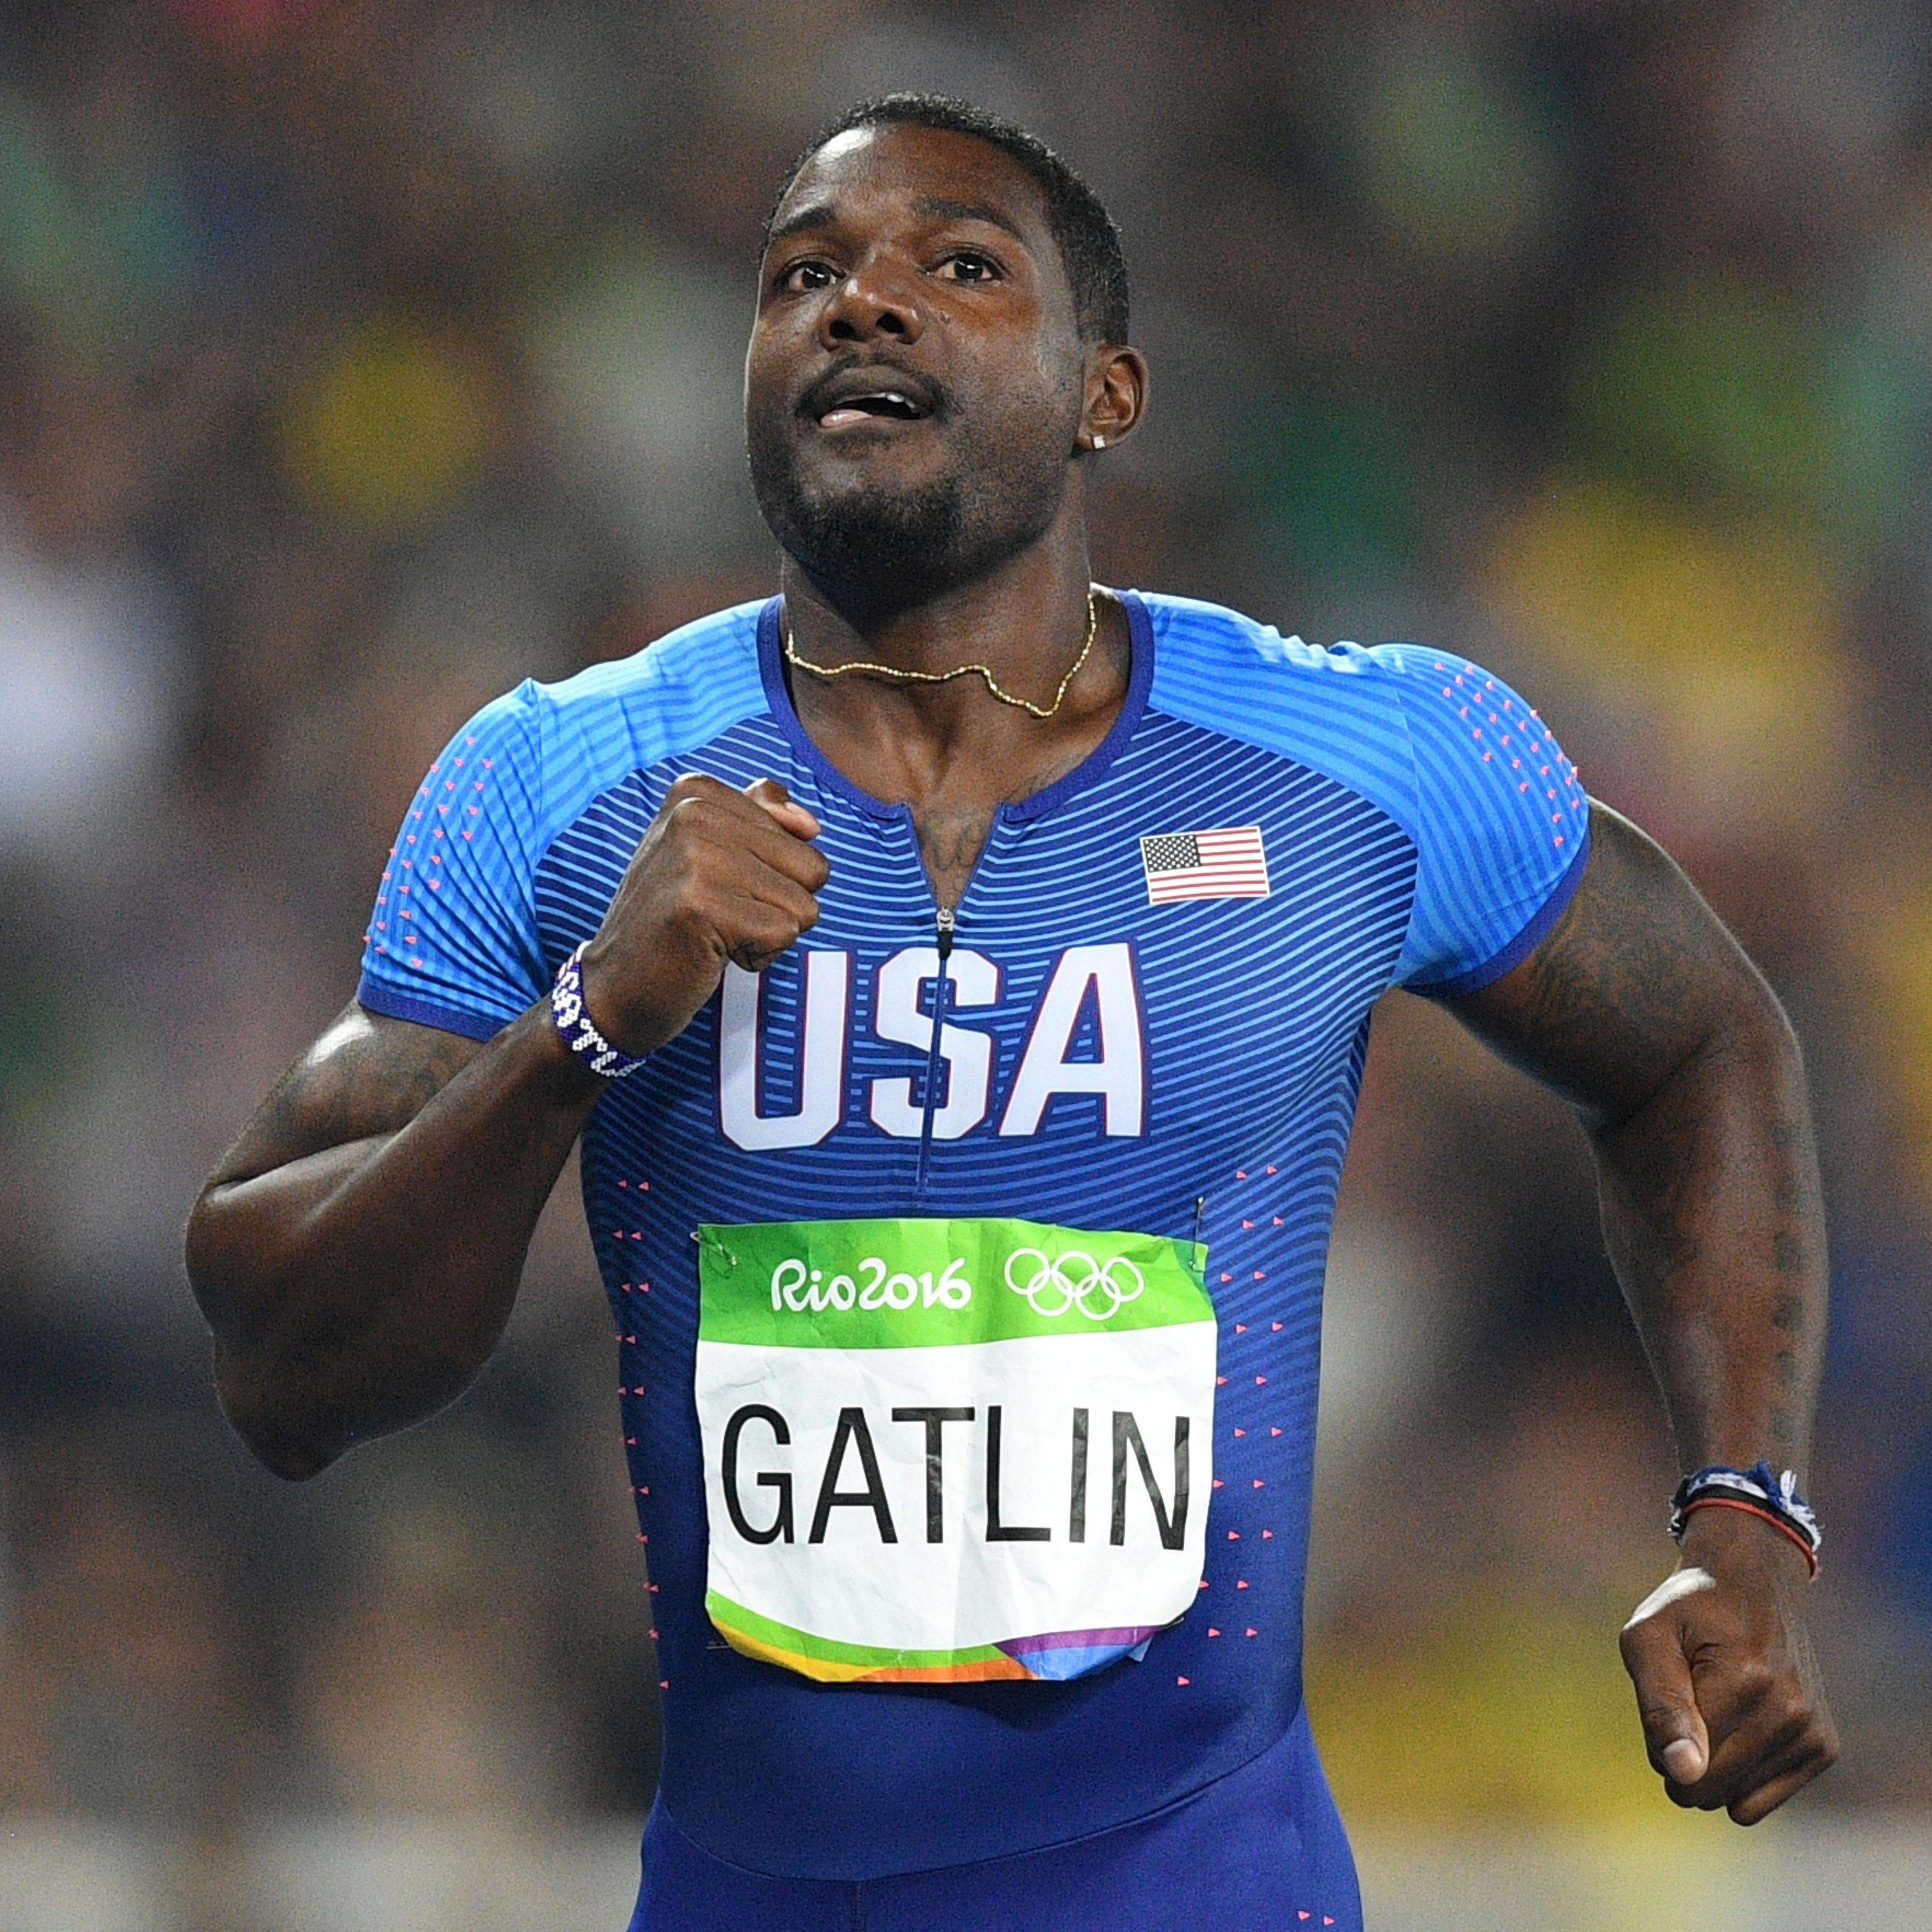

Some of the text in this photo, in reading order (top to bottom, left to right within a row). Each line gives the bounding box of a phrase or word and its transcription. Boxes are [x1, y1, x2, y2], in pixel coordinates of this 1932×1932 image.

[719, 942, 1144, 1151] USA
[771, 1257, 972, 1312] Rio2016
[721, 1404, 1190, 1551] GATLIN
